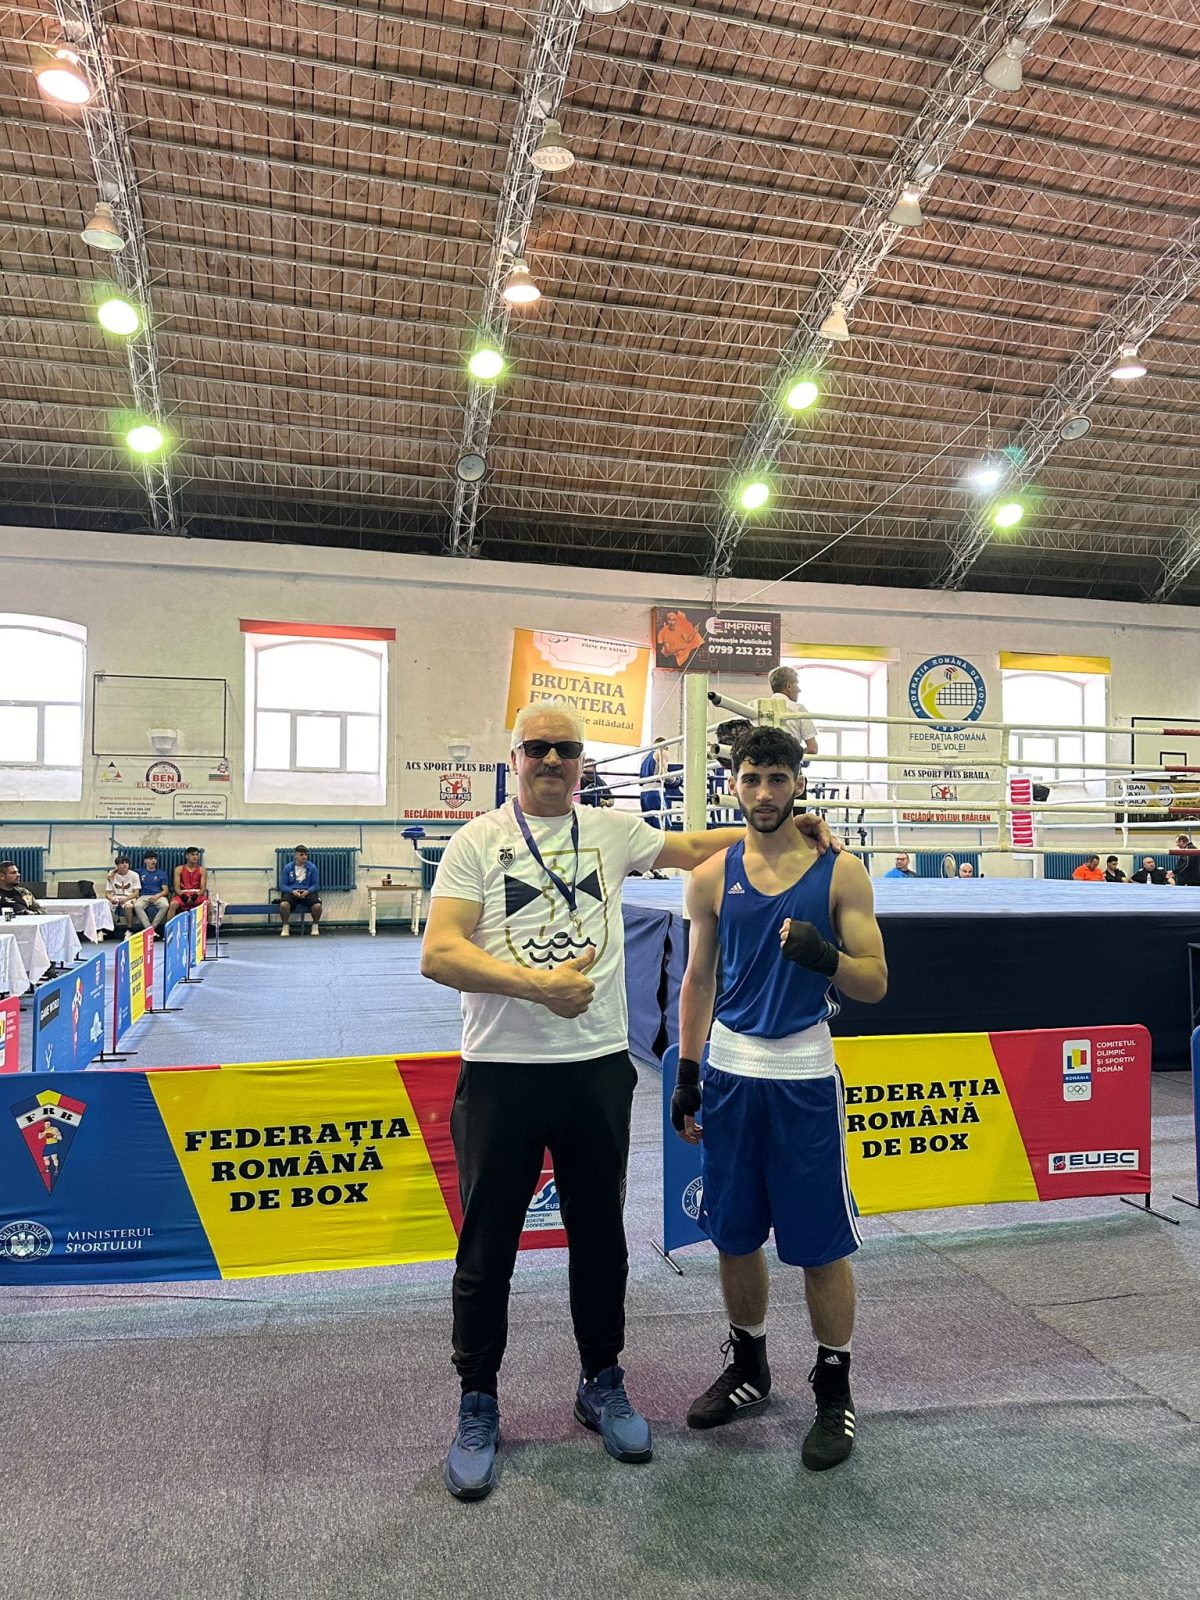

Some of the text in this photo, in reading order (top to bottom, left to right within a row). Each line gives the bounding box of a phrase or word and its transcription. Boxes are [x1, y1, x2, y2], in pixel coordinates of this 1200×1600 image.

[708, 645, 772, 656] 0799 232 232
[405, 761, 421, 770] ACS
[423, 762, 452, 771] SPORT
[456, 763, 476, 771] PLUS
[152, 774, 175, 782] BEN
[903, 769, 916, 777] ACS
[917, 769, 942, 778] SPORT
[944, 771, 962, 779] PLUS
[136, 781, 190, 789] ELECTROSERV
[444, 810, 474, 819] VOLEIUL
[1096, 1040, 1136, 1048] COMITETUL
[1105, 1056, 1136, 1064] SPORTIV
[1096, 1065, 1124, 1073] ROMÂN
[845, 1078, 1001, 1103] EDERAȚIA
[847, 1102, 980, 1133] ROMÂNĂ
[185, 1118, 411, 1152] FEDERAȚIA
[862, 1133, 969, 1159] DE BOX
[211, 1145, 384, 1182] ROMÂNĂ
[1069, 1152, 1135, 1166] EUBC
[230, 1182, 369, 1212] DE BOX
[65, 1240, 142, 1253] SPORTULUI
